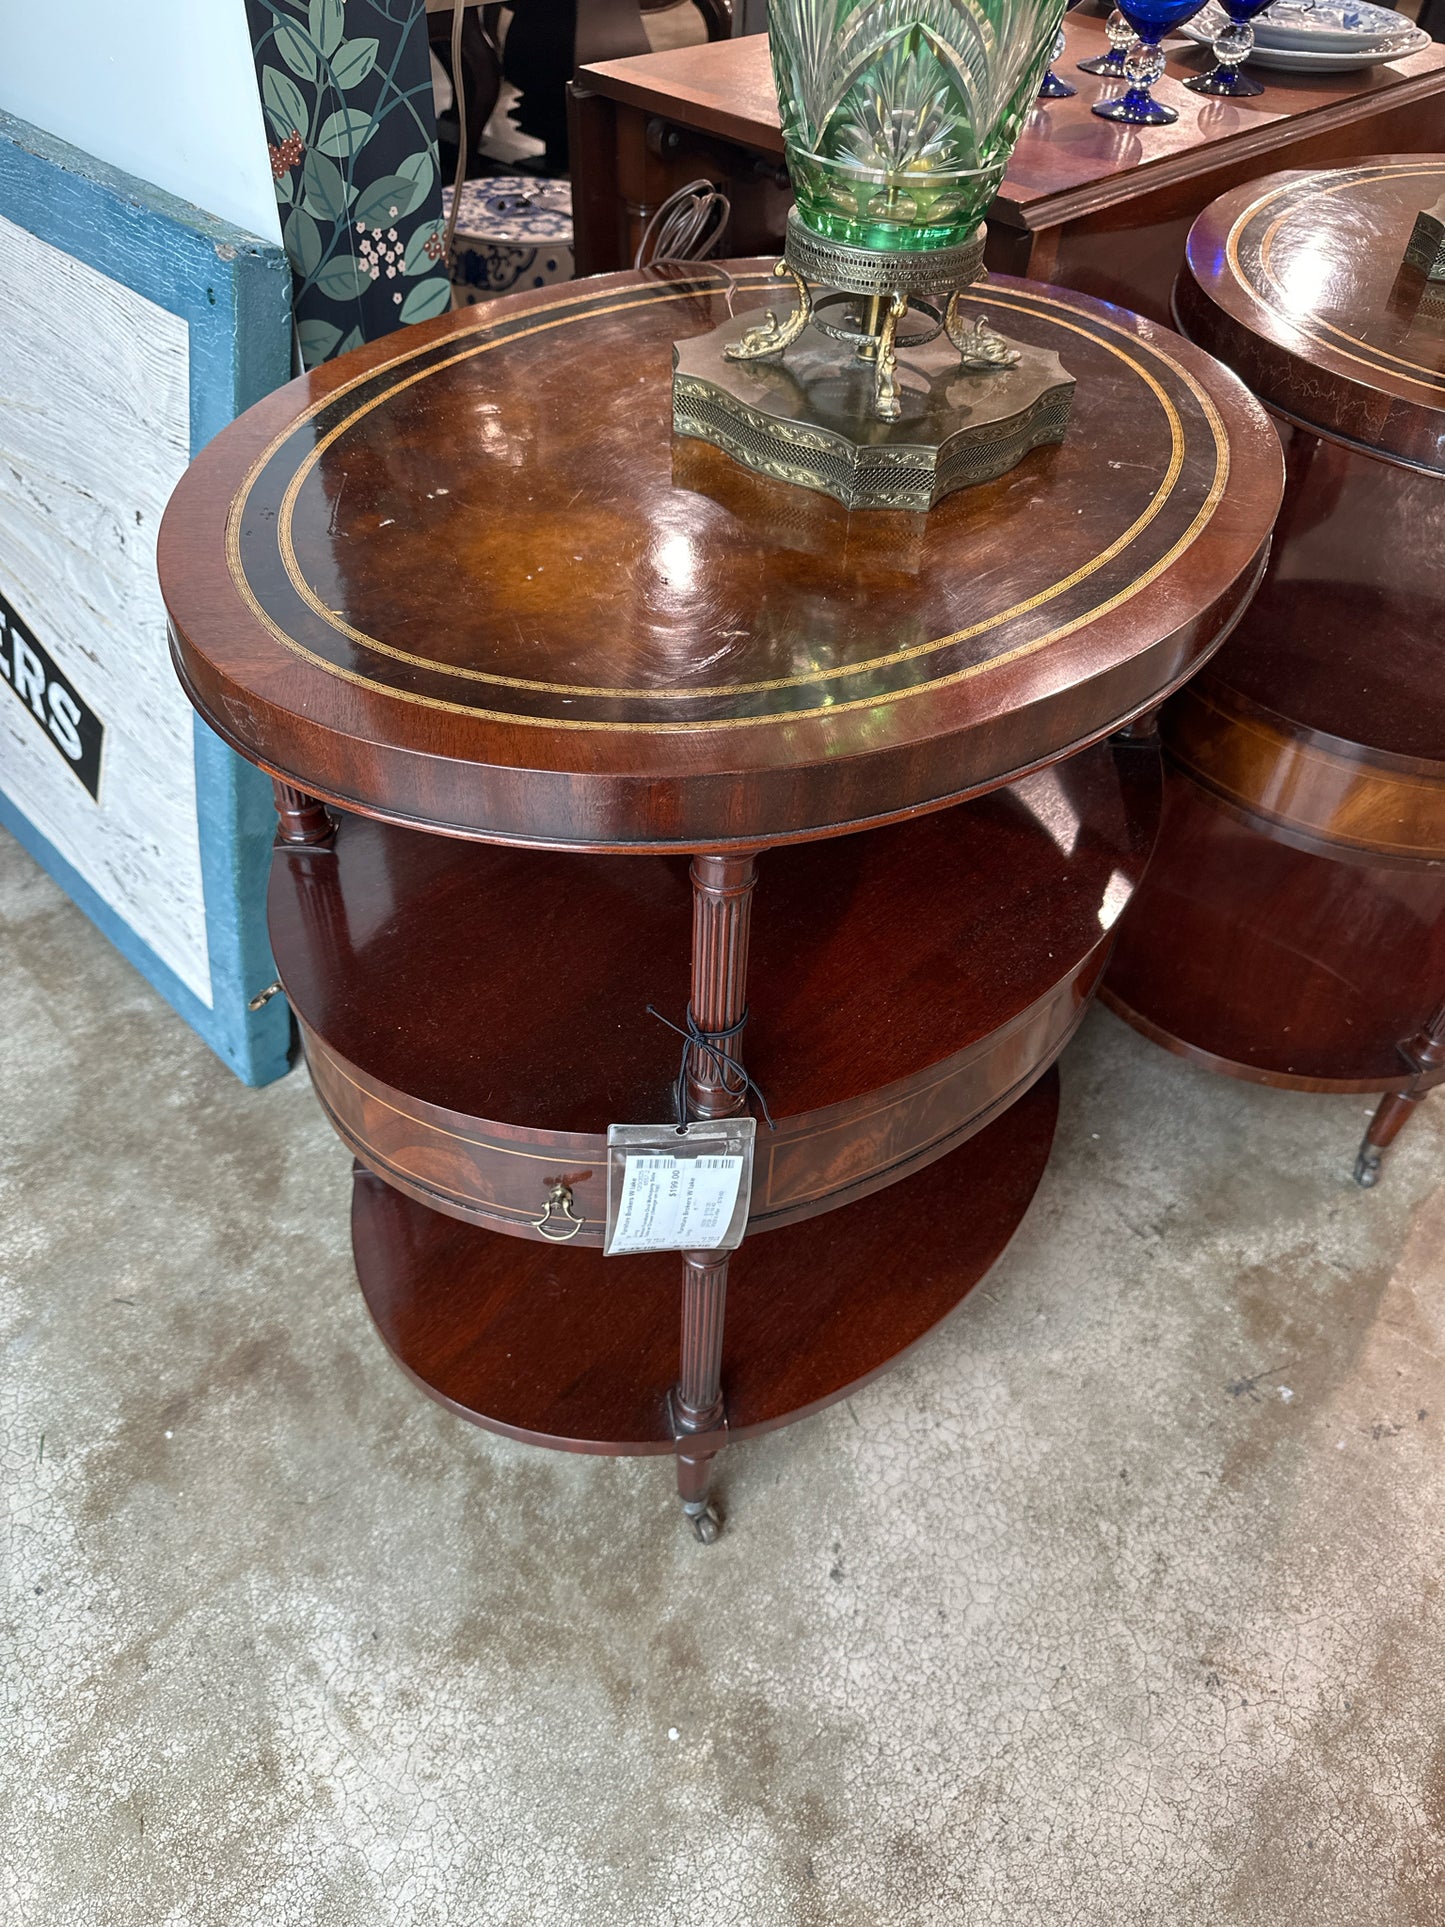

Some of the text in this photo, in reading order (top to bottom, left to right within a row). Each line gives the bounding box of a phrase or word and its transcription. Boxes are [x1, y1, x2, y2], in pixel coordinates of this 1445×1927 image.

[669, 1170, 680, 1197] $199.00
[625, 1197, 634, 1216] Brokers
[683, 1197, 692, 1216] Brokers
